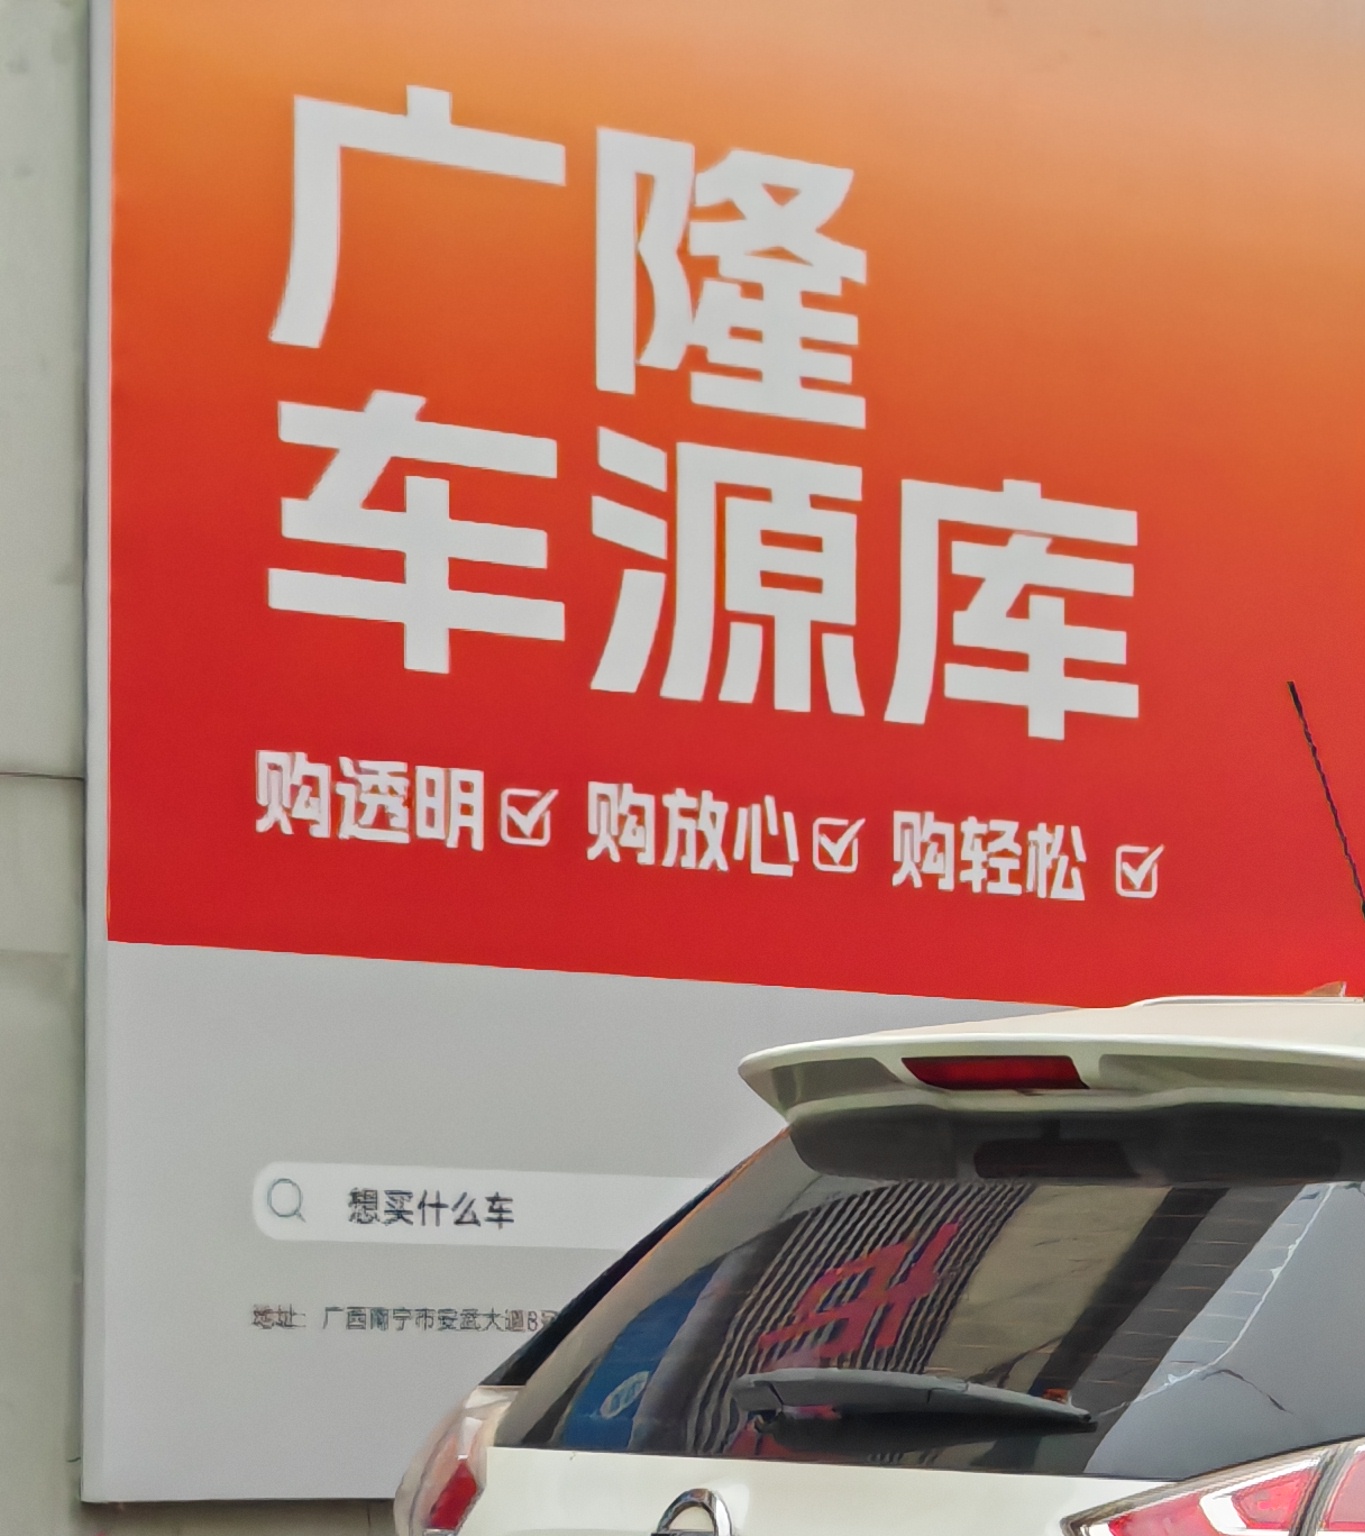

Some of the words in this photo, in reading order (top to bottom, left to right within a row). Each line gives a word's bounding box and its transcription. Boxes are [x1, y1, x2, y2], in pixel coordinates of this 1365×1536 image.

[269, 86, 867, 430] 广隆
[268, 389, 1141, 742] 车源库
[255, 749, 486, 852] 购透明
[586, 780, 800, 878] 购放心
[890, 810, 1089, 904] 购轻松
[348, 1187, 515, 1229] 想买什么车
